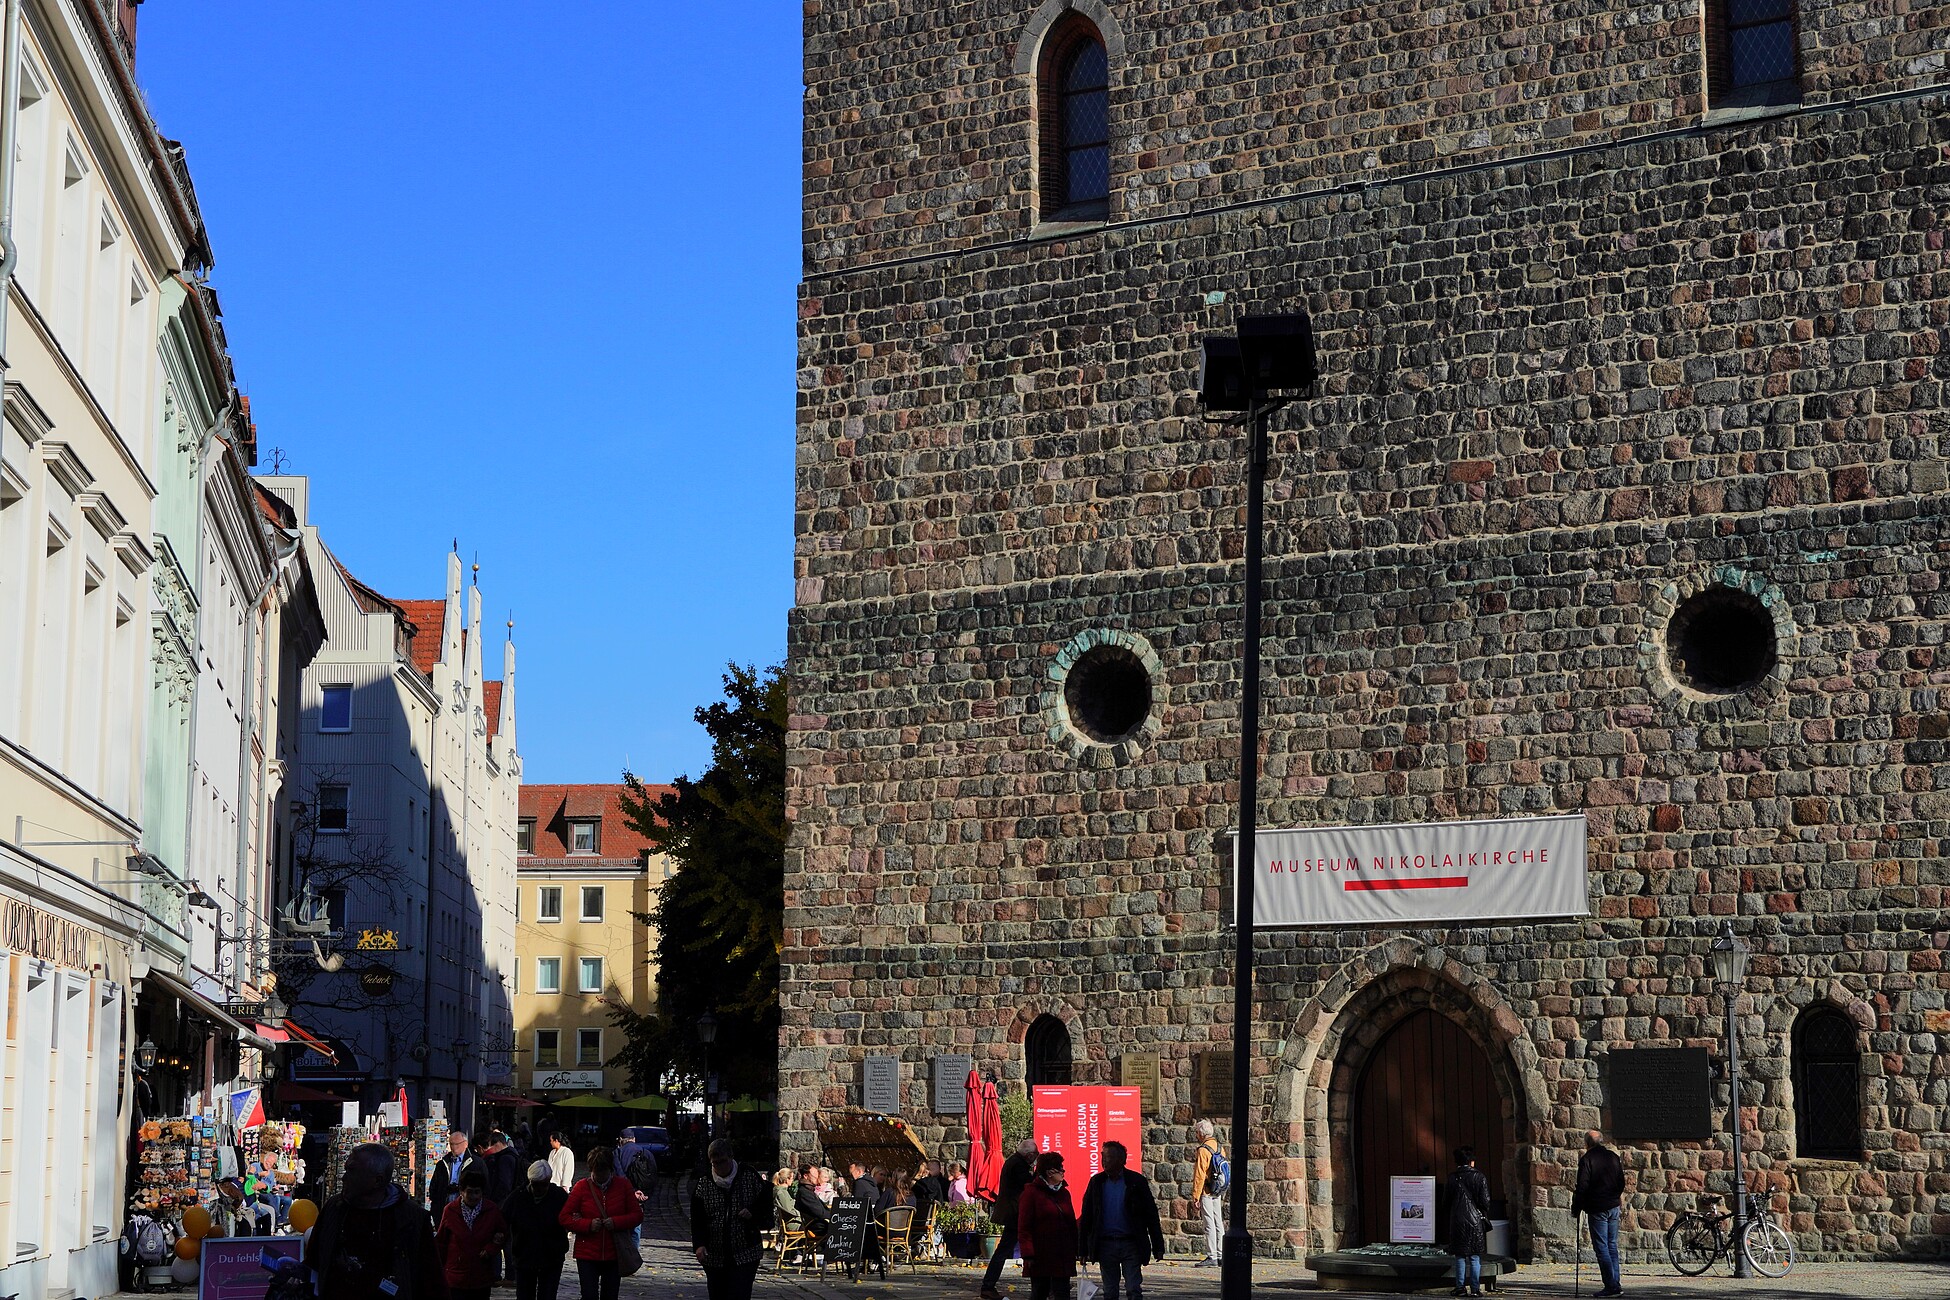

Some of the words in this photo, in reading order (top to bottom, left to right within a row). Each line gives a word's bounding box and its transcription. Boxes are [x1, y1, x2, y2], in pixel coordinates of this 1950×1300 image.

[1269, 857, 1360, 874] MUSEUM
[1373, 848, 1549, 870] NIKOLAIKIRCHE
[3, 898, 59, 962] ORDINARY
[59, 920, 91, 973] MAGIC
[1077, 1103, 1087, 1148] MUSEUM
[1042, 1135, 1050, 1152] Uhr
[1055, 1132, 1062, 1148] pm
[1089, 1103, 1099, 1177] NIKOLAIKIRCHE
[218, 1254, 234, 1264] Du
[236, 1253, 261, 1263] fehls
